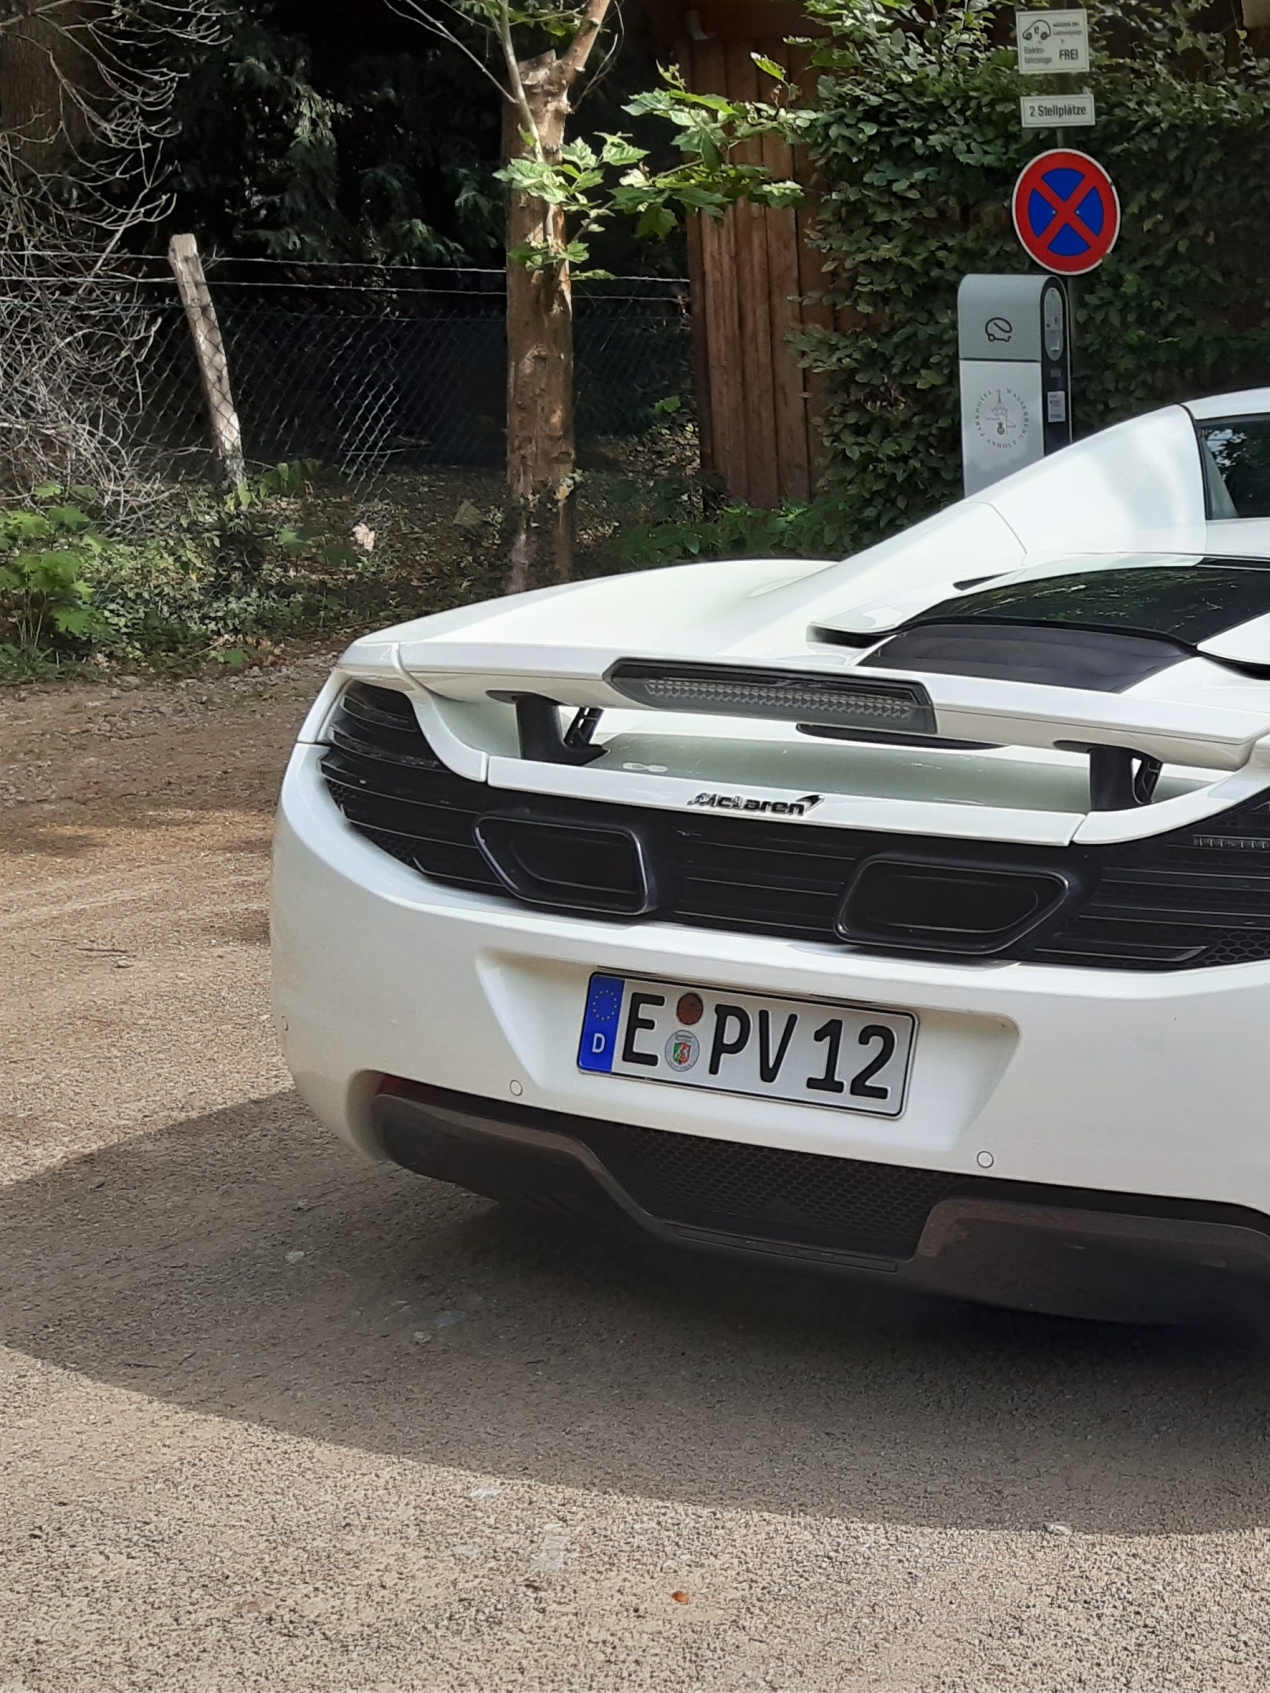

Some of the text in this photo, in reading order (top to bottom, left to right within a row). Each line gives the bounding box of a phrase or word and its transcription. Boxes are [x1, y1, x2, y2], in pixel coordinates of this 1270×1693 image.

[1059, 49, 1078, 60] FREI
[1029, 104, 1087, 118] 2 Stellplätze
[687, 792, 805, 816] McLaren
[622, 992, 665, 1066] E
[592, 1033, 605, 1054] D
